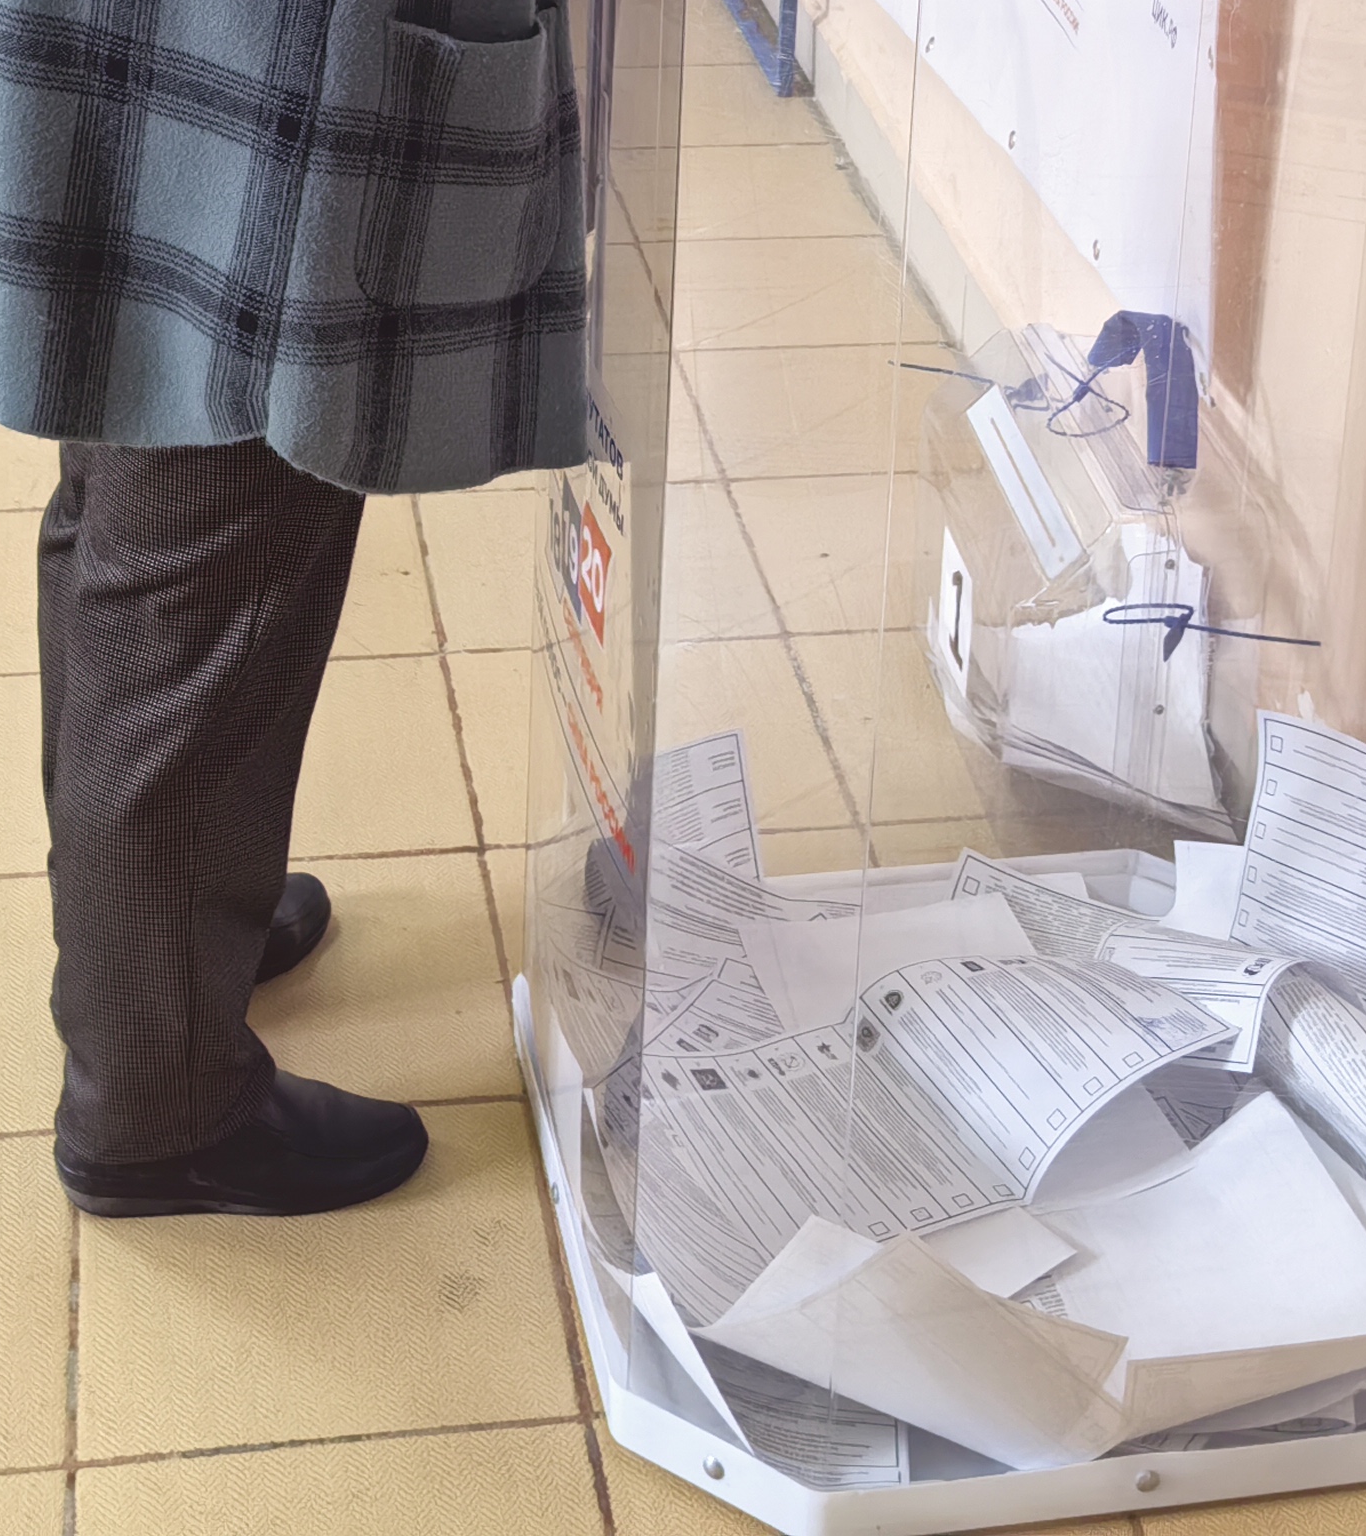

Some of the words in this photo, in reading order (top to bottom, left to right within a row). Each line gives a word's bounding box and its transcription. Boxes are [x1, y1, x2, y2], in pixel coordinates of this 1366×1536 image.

[549, 498, 561, 573] 18
[563, 510, 579, 585] 19
[581, 525, 604, 613] 20
